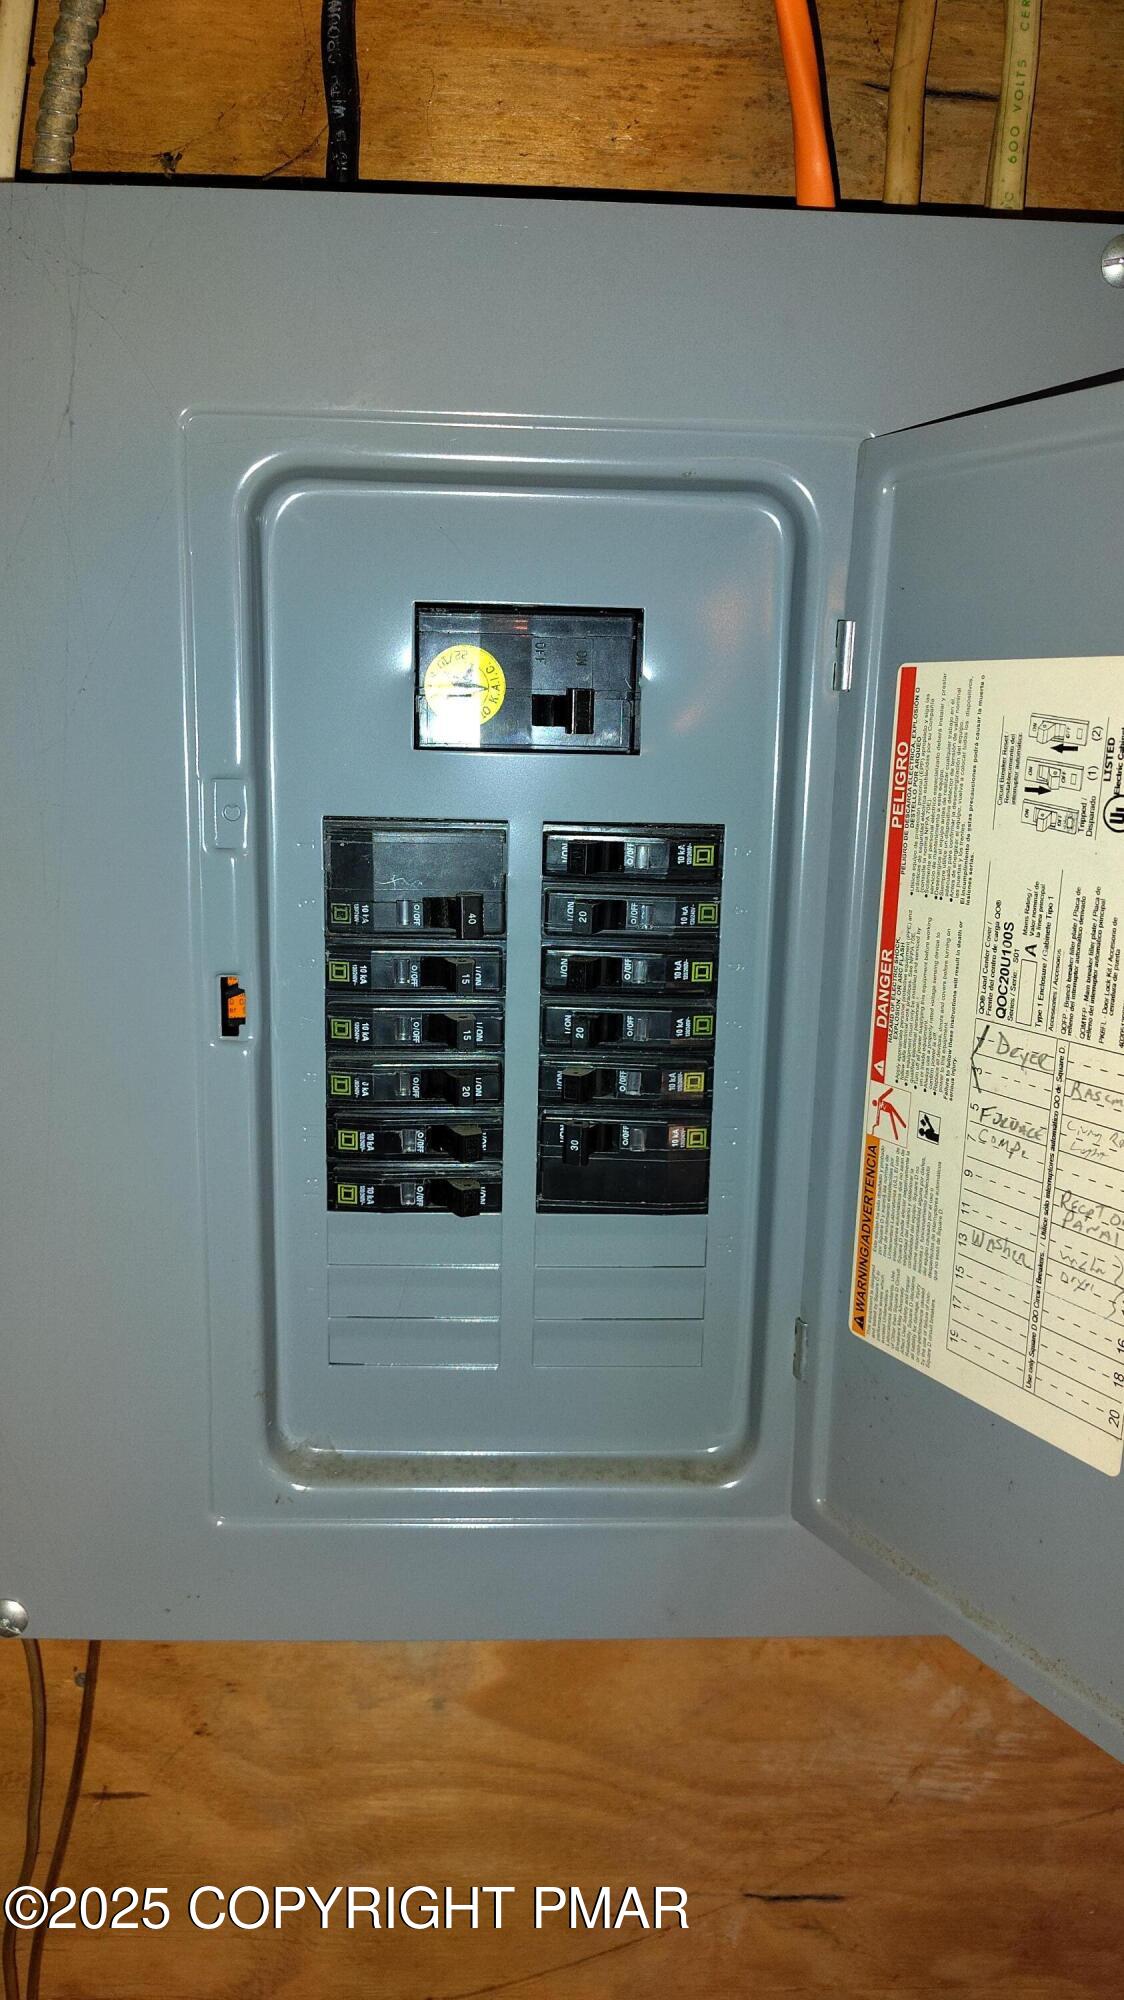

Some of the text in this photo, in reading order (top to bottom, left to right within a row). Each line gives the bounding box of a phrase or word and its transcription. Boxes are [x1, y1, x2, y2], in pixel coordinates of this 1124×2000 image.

[1012, 59, 1027, 112] VOLTS
[1008, 126, 1020, 163] 600
[1091, 726, 1103, 741] (2)
[1103, 737, 1115, 781] LISTED
[1087, 765, 1098, 780] (1)
[891, 741, 909, 828] PELIGRO
[904, 785, 912, 828] DESCARGA
[1078, 802, 1087, 833] Tripped
[1085, 795, 1096, 836] Disparado
[903, 830, 908, 840] DE
[678, 856, 685, 864] 10
[1034, 880, 1039, 889] de
[468, 913, 476, 925] 40
[579, 911, 587, 923] 20
[680, 906, 688, 925] 10 kA
[991, 943, 997, 952] de
[1024, 942, 1036, 957] A
[1038, 962, 1047, 1000] Enclosure
[1043, 921, 1051, 956] Gabinete
[360, 965, 367, 984] 10 kA
[674, 961, 682, 979] 10 kA
[995, 921, 1014, 1019] QOC20U100S
[462, 974, 470, 984] 15
[876, 947, 892, 1028] DANGER
[897, 984, 901, 995] OR
[890, 1001, 895, 1012] OF
[576, 1027, 584, 1038] 20
[675, 1018, 683, 1037] 10 kA
[362, 1031, 369, 1041] kA
[463, 1030, 471, 1041] 15
[1056, 1055, 1065, 1083] Square
[668, 1073, 676, 1091] 10 kA
[362, 1088, 369, 1096] kA
[462, 1086, 470, 1097] 20
[970, 1102, 979, 1110] 5
[1053, 1094, 1060, 1109] QO
[367, 1133, 374, 1151] 10 kA
[672, 1129, 679, 1147] 10 kA
[967, 1133, 975, 1142] 7
[570, 1140, 578, 1151] 30
[964, 1168, 972, 1177] 9
[1044, 1152, 1056, 1199] interruptores
[367, 1187, 375, 1205] 10 kA
[961, 1200, 970, 1215] 11
[854, 1142, 877, 1314] WARNING/ADVERTENCIA
[958, 1231, 967, 1248] 13
[955, 1264, 964, 1280] 15
[952, 1295, 961, 1310] 17
[1032, 1308, 1038, 1323] QO
[1031, 1323, 1037, 1331] D
[1028, 1330, 1037, 1358] Square
[1113, 1371, 1124, 1389] 18
[1108, 1409, 1120, 1428] 20
